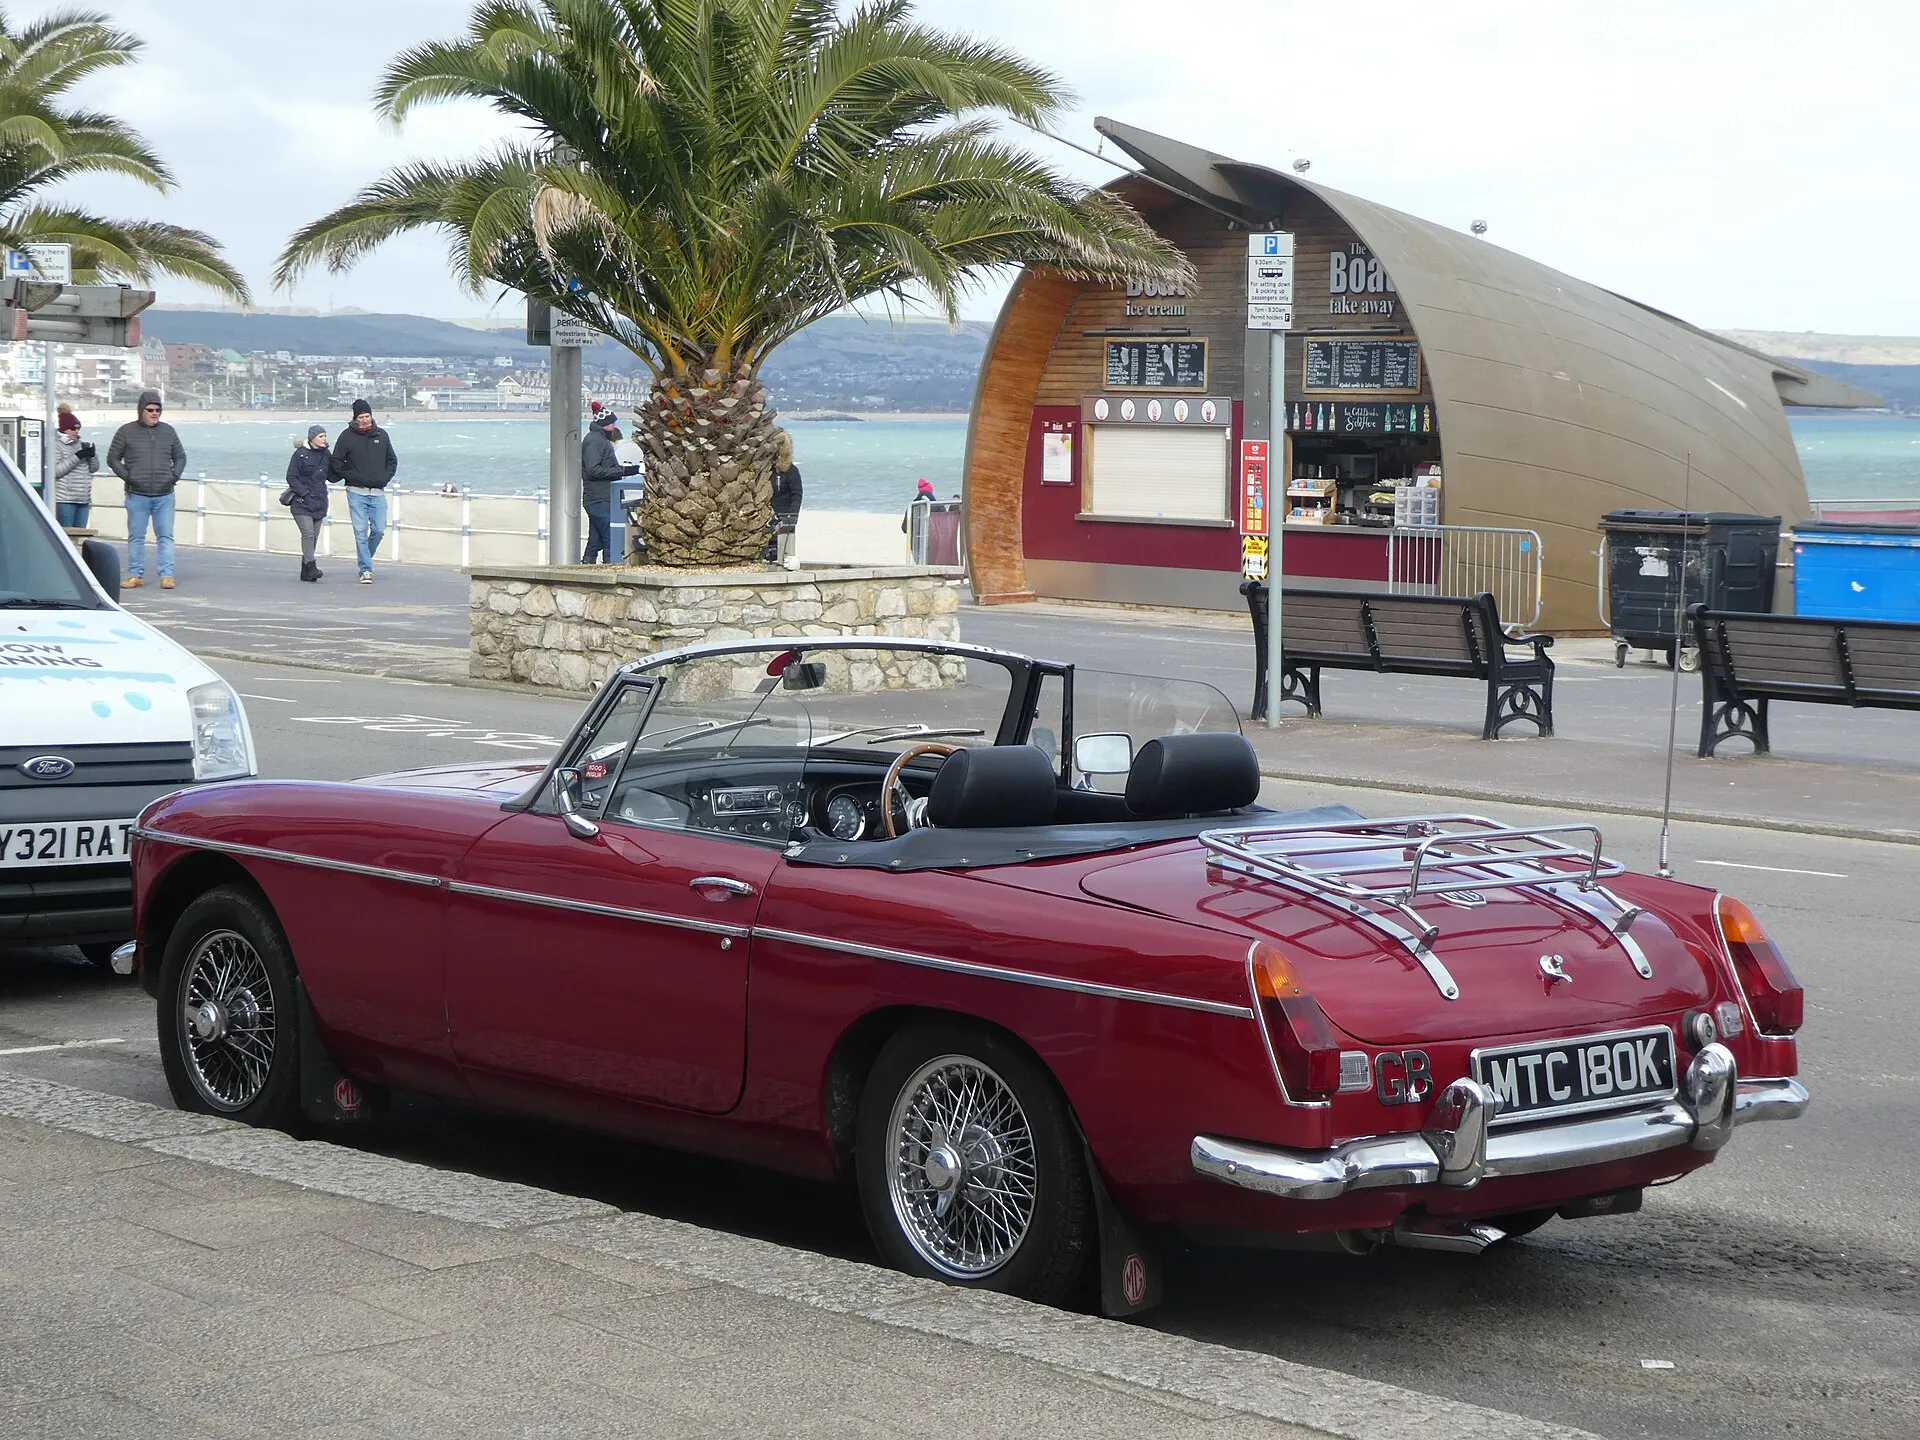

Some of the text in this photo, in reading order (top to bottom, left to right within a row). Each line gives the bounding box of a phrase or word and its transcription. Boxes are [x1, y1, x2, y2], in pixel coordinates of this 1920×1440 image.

[1266, 237, 1276, 253] P
[1350, 242, 1366, 255] The
[1126, 301, 1185, 316] ice cream
[1329, 295, 1395, 318] take away
[36, 760, 64, 773] Ford
[75, 823, 132, 857] RAT
[1374, 1049, 1434, 1106] GB
[1491, 1037, 1662, 1107] MTC 180K
